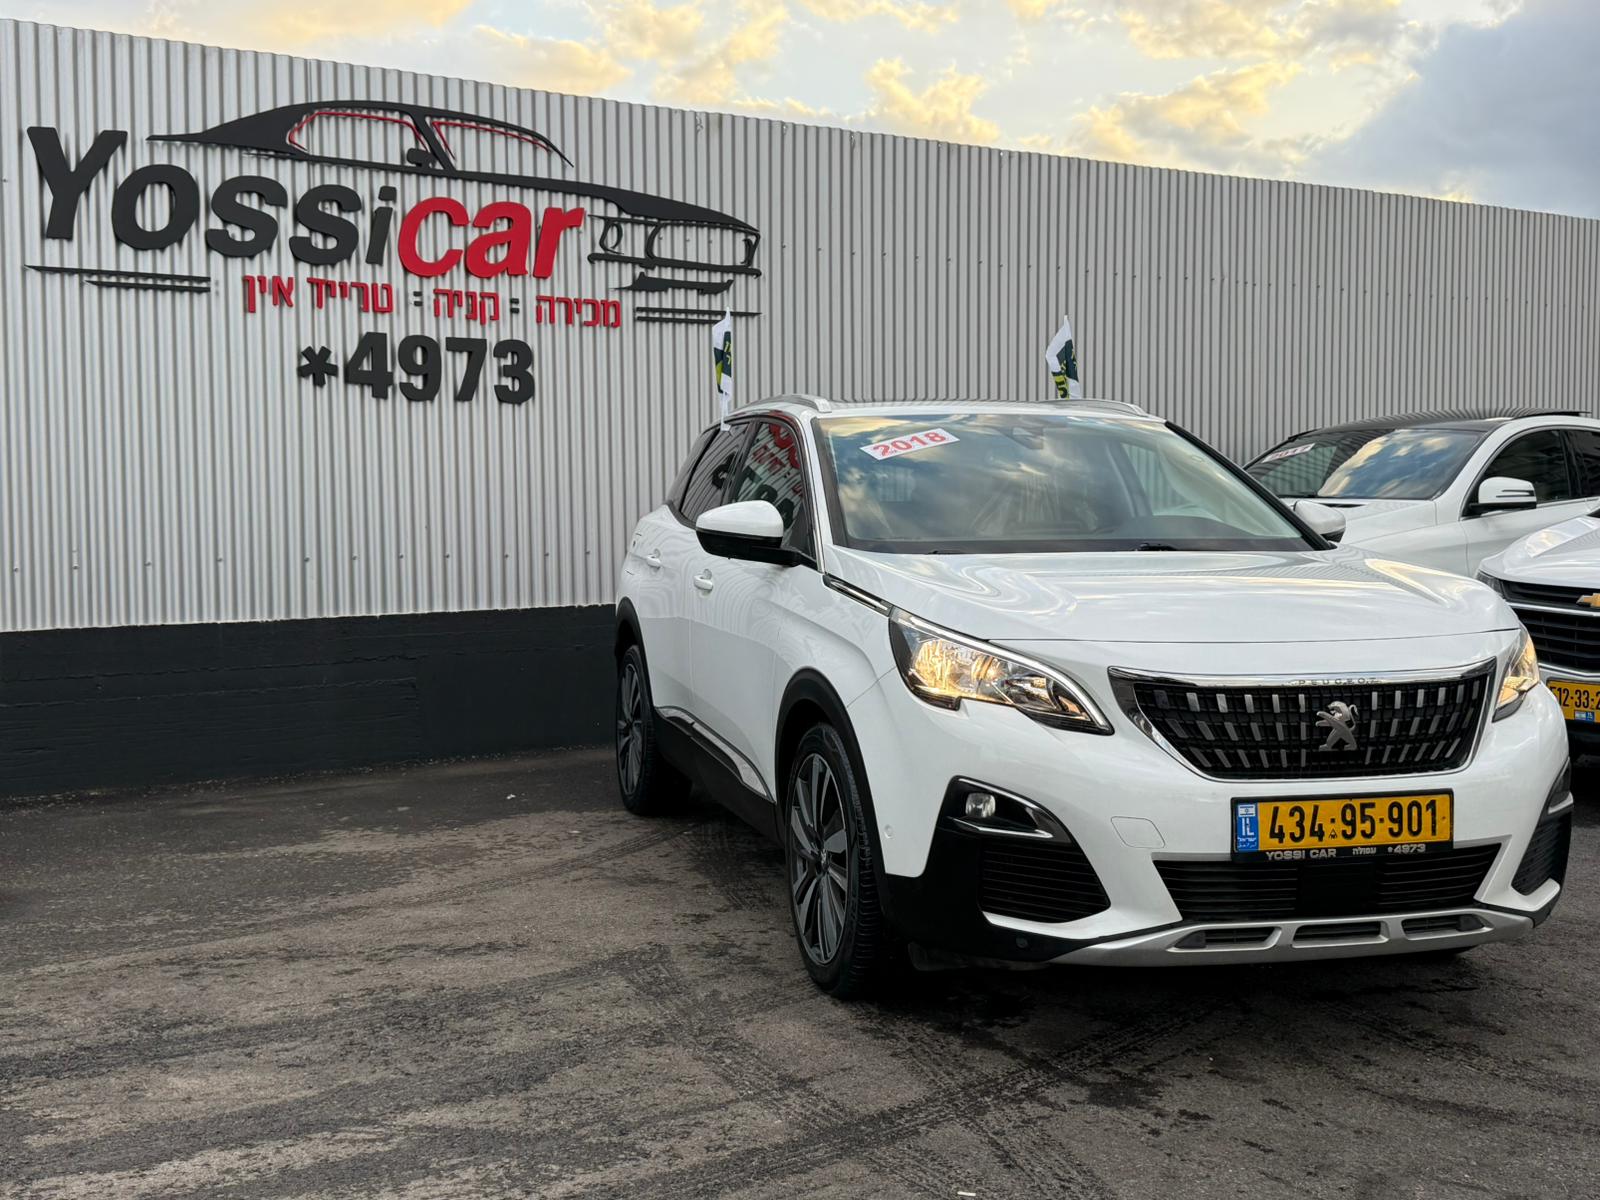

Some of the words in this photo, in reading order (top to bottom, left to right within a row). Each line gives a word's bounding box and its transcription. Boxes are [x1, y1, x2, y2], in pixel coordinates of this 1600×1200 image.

[243, 275, 294, 313] אין
[307, 277, 394, 313] טרייד
[433, 288, 500, 325] קניה
[535, 295, 622, 328] מכירה
[873, 432, 946, 456] 2018
[1242, 818, 1255, 836] IL
[1265, 850, 1305, 861] YOSSI
[1310, 848, 1337, 859] CAR
